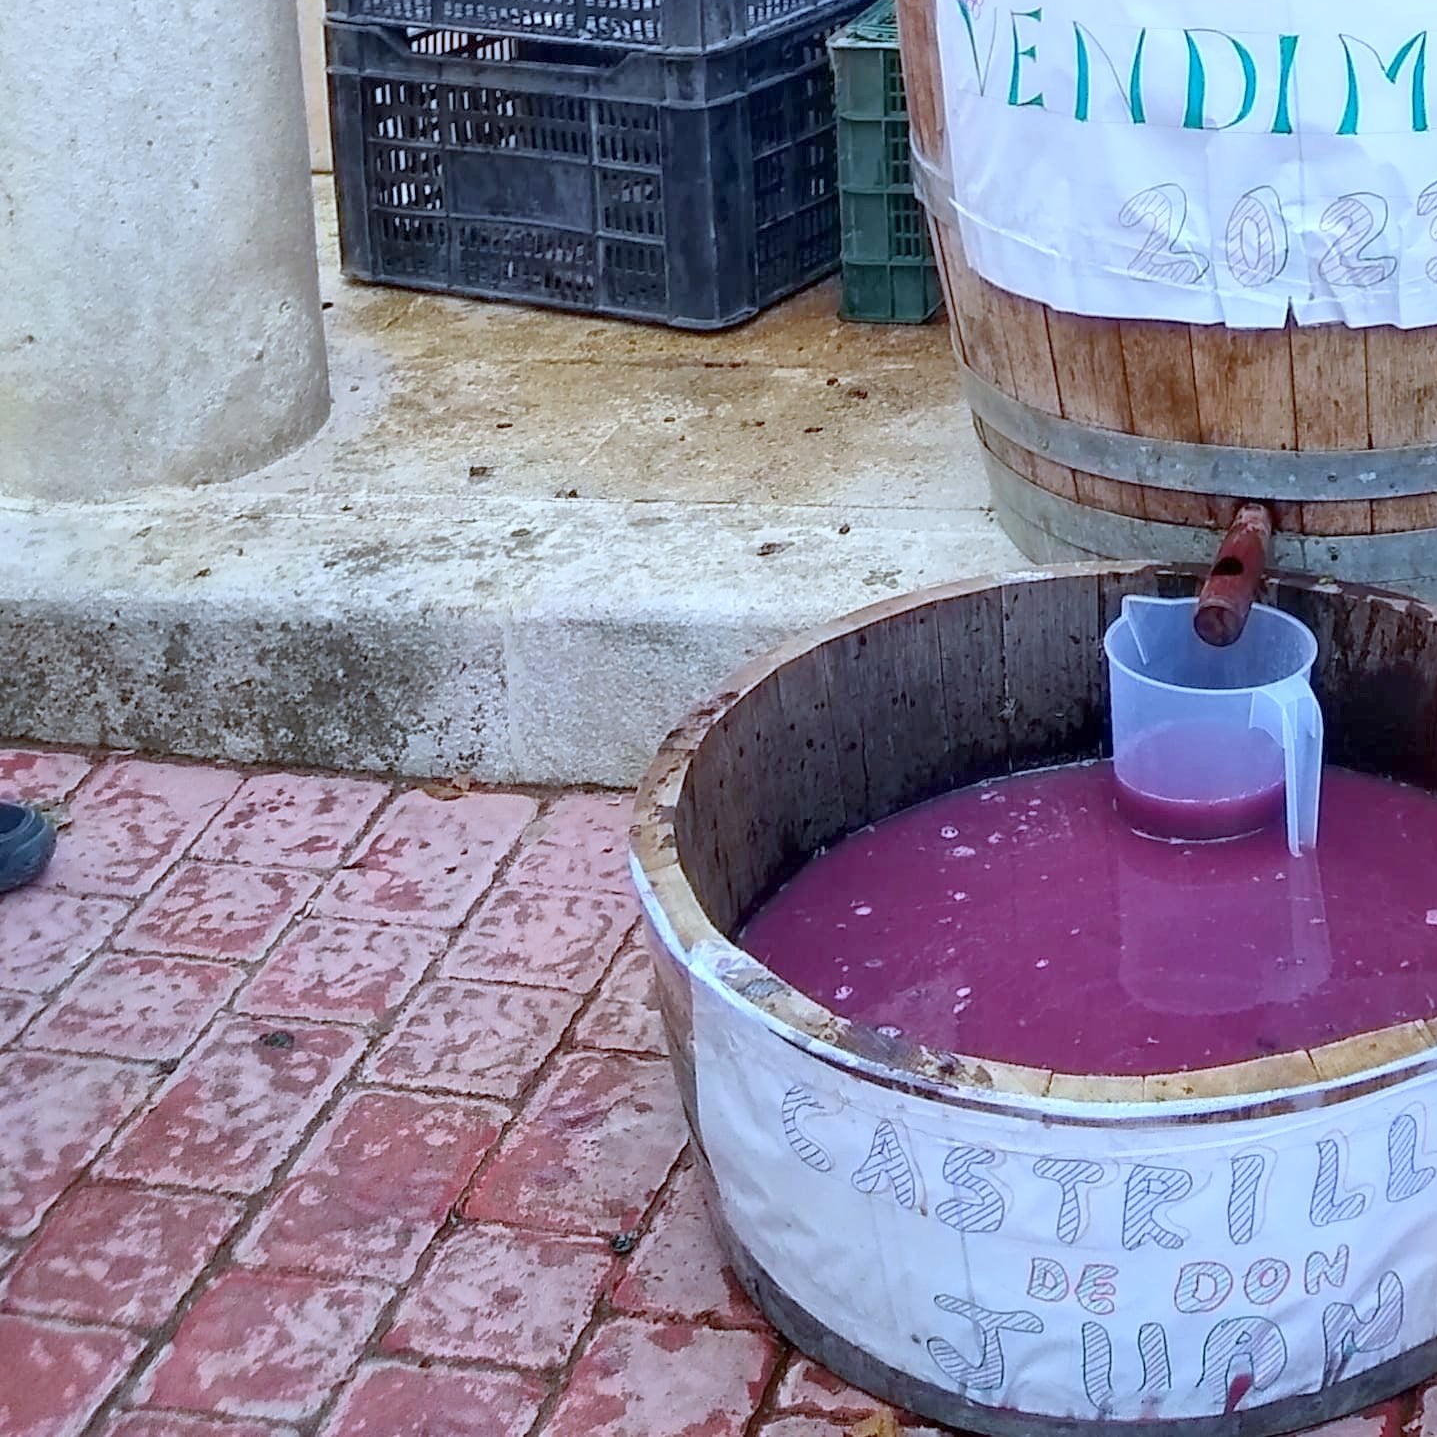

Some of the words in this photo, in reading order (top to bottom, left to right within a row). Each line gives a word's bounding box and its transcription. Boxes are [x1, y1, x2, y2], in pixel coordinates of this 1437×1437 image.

[1026, 1257, 1120, 1316] DE
[1173, 1244, 1350, 1314] DON
[926, 1271, 1405, 1415] JUAN
